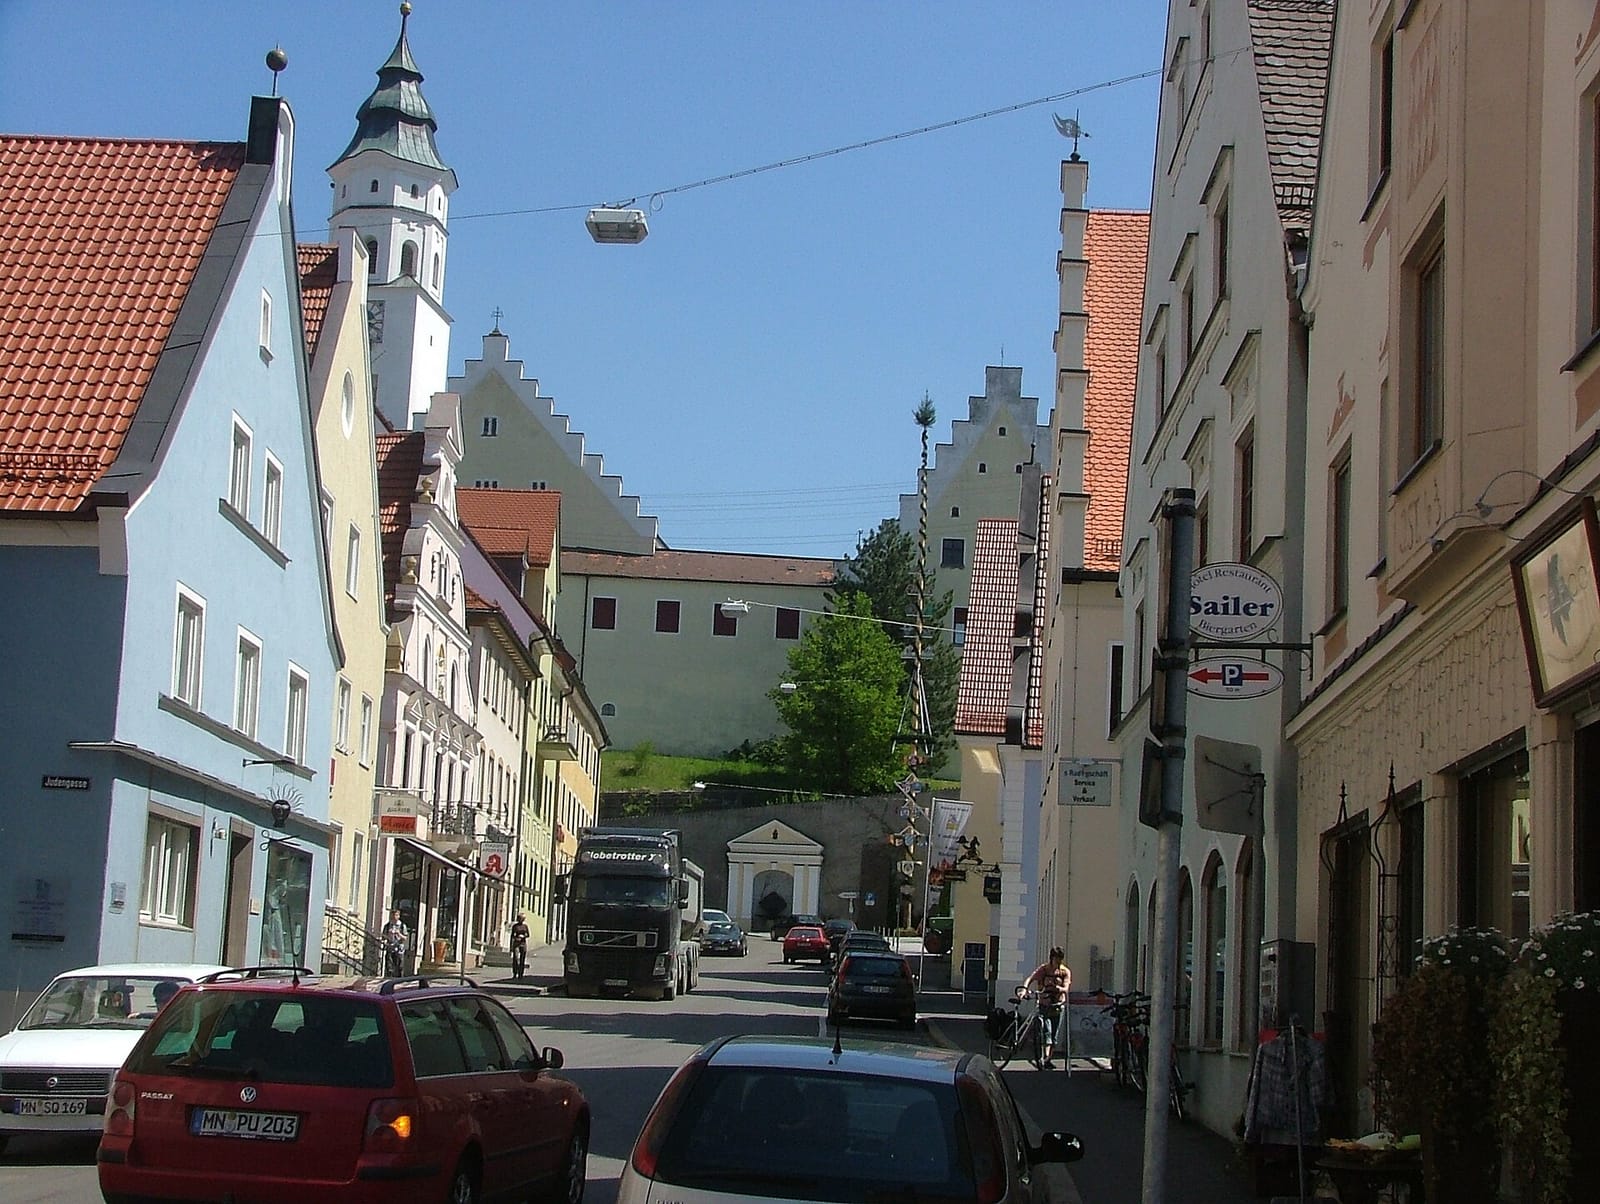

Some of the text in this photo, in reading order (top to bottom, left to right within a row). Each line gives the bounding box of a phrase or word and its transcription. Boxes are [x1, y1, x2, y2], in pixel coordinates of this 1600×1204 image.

[1214, 568, 1271, 593] Restaurant
[1190, 595, 1274, 616] Sailer
[1199, 619, 1258, 636] Biergarten
[1225, 666, 1240, 685] P
[44, 777, 88, 789] Judengasse
[587, 851, 647, 861] lobetrotter
[141, 1091, 174, 1101] PASSAT
[21, 1100, 37, 1114] MN
[62, 1102, 85, 1115] 169
[202, 1112, 297, 1135] MN PU 203
